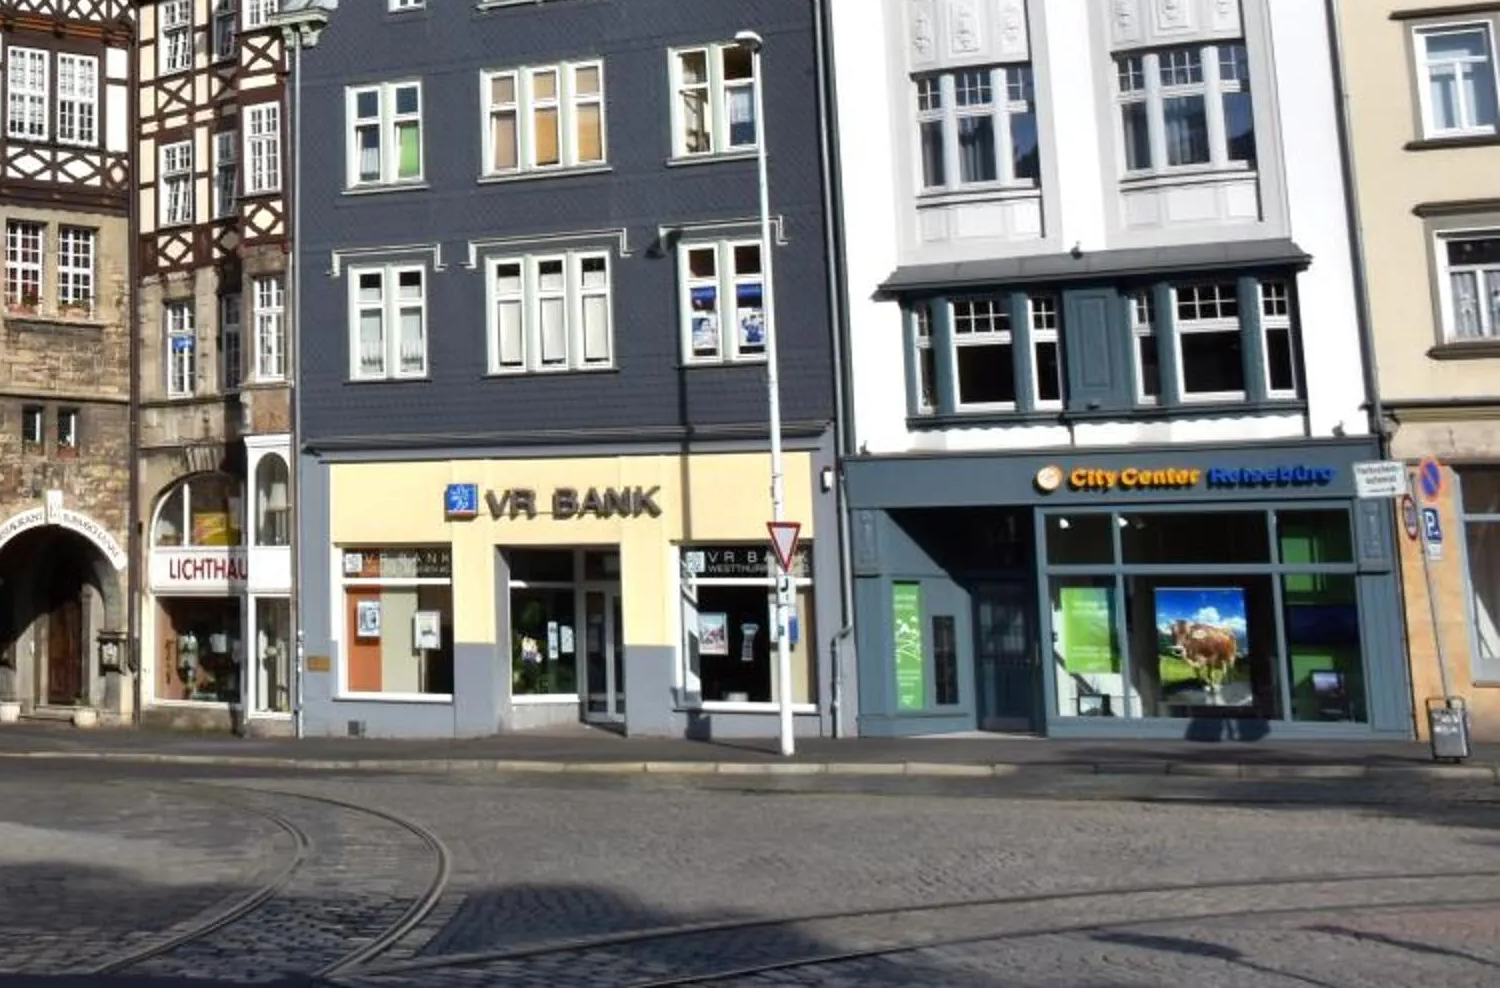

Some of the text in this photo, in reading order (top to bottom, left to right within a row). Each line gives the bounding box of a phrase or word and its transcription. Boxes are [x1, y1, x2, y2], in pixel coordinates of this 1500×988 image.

[1069, 466, 1117, 488] City
[1120, 466, 1202, 487] Center
[485, 485, 663, 521] VR BANK
[169, 557, 248, 581] LICHTHAU
[707, 551, 734, 564] VR
